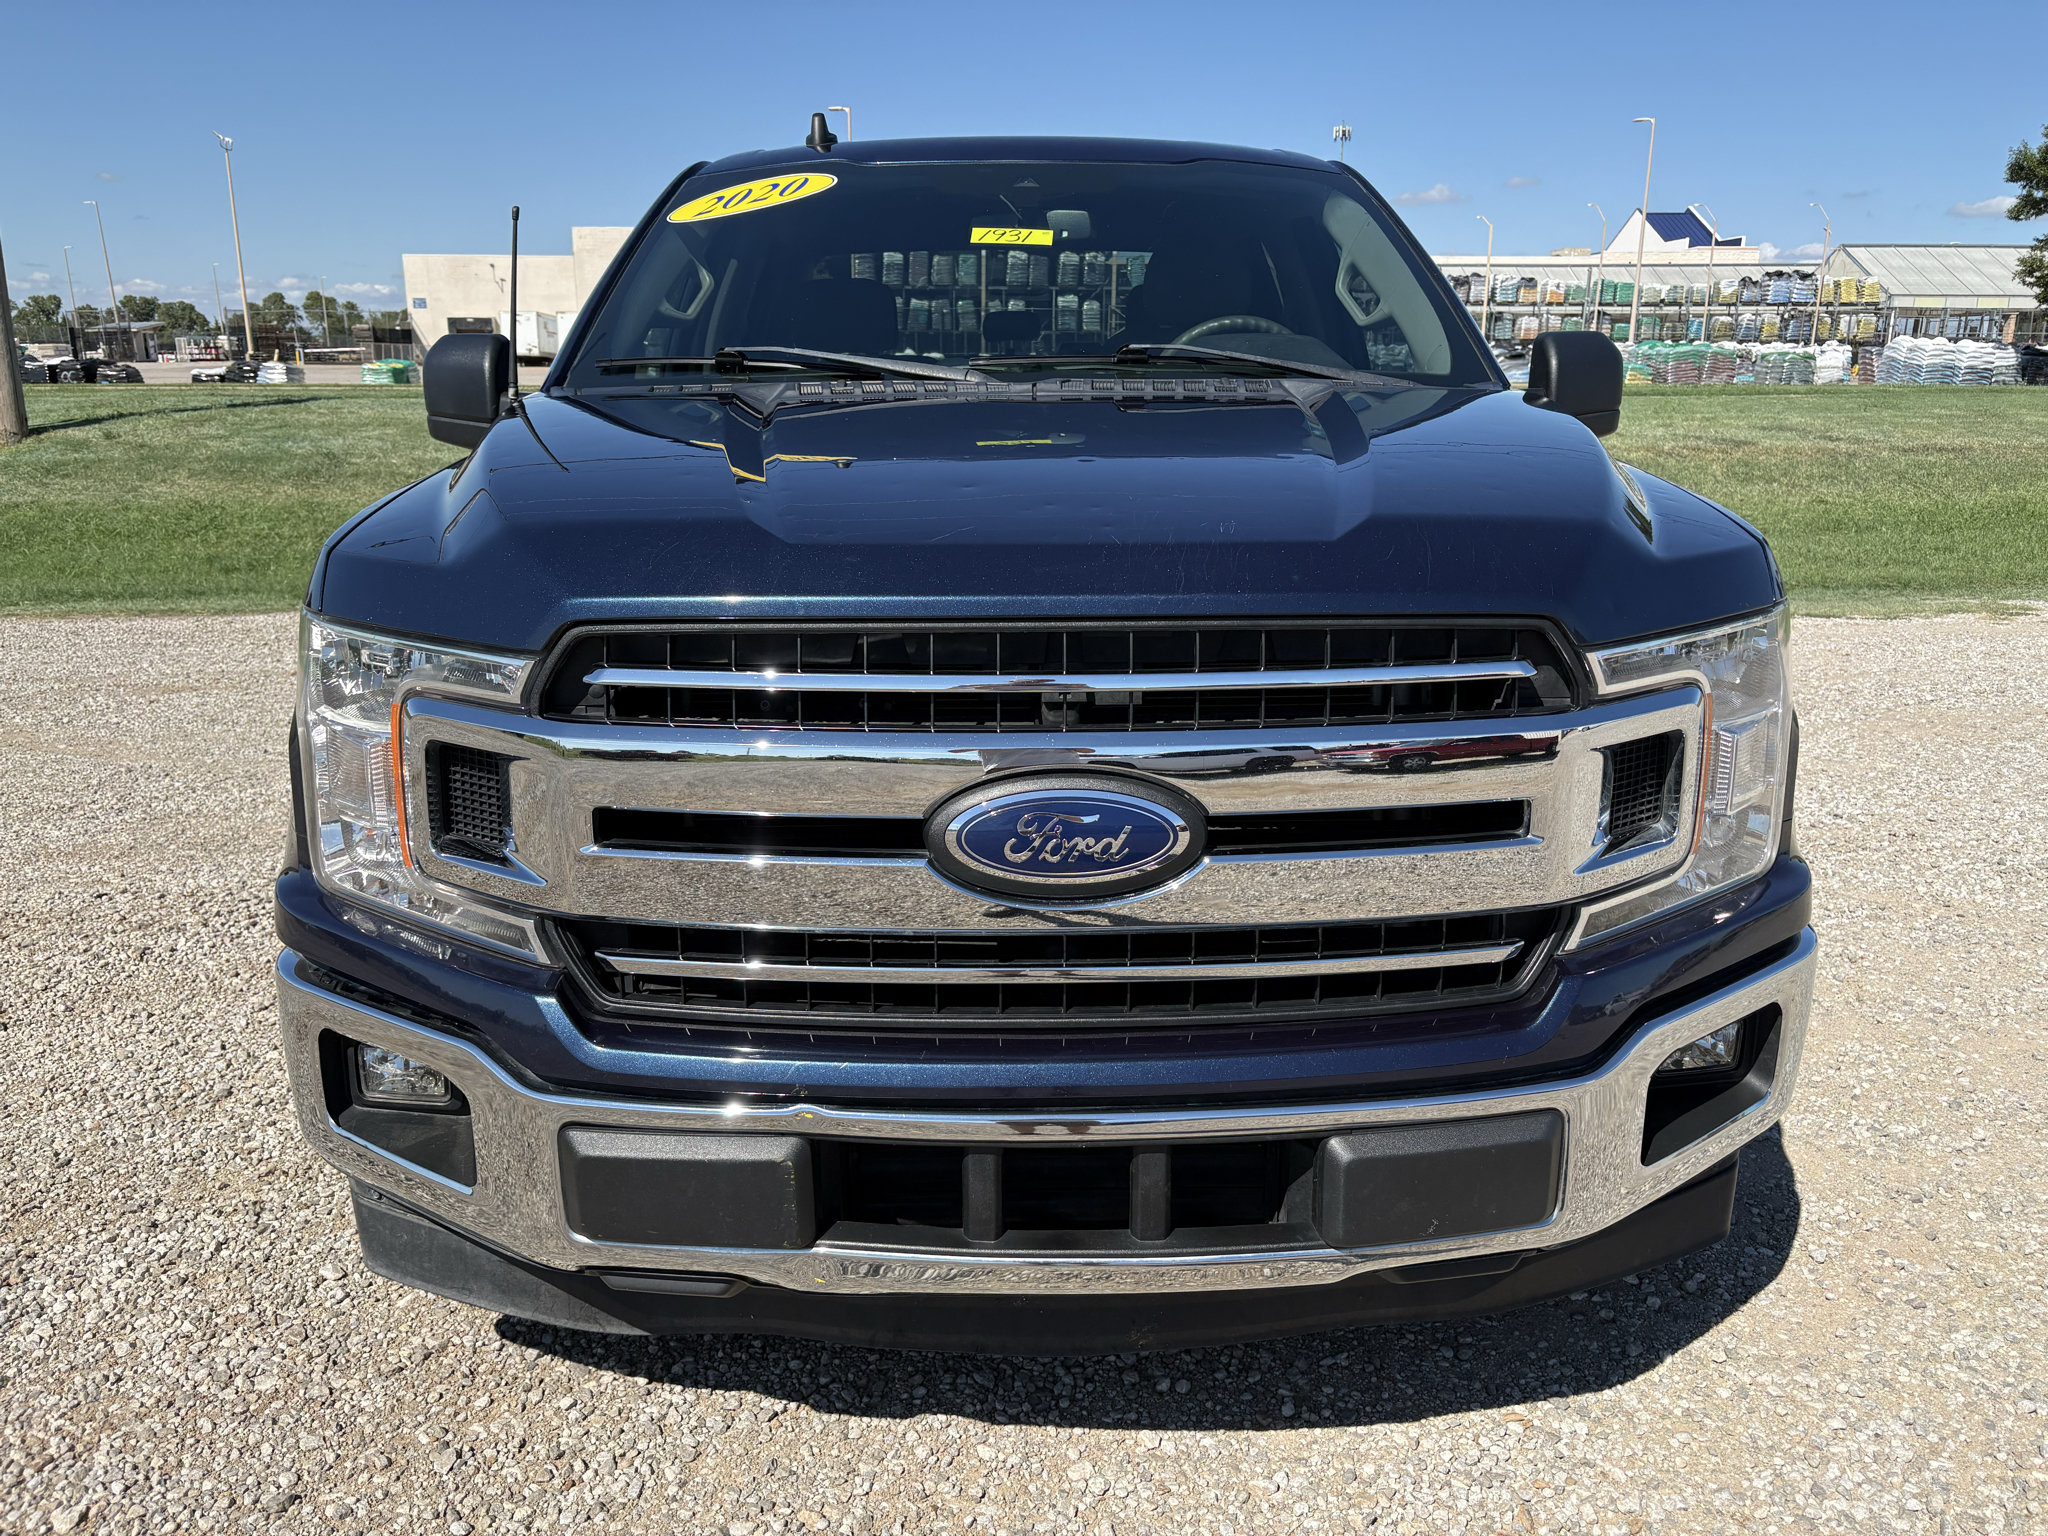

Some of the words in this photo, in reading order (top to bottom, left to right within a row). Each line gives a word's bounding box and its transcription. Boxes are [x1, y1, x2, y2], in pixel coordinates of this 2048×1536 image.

[692, 177, 809, 217] 2020
[978, 229, 1033, 243] 1931
[1003, 811, 1132, 863] Ford
